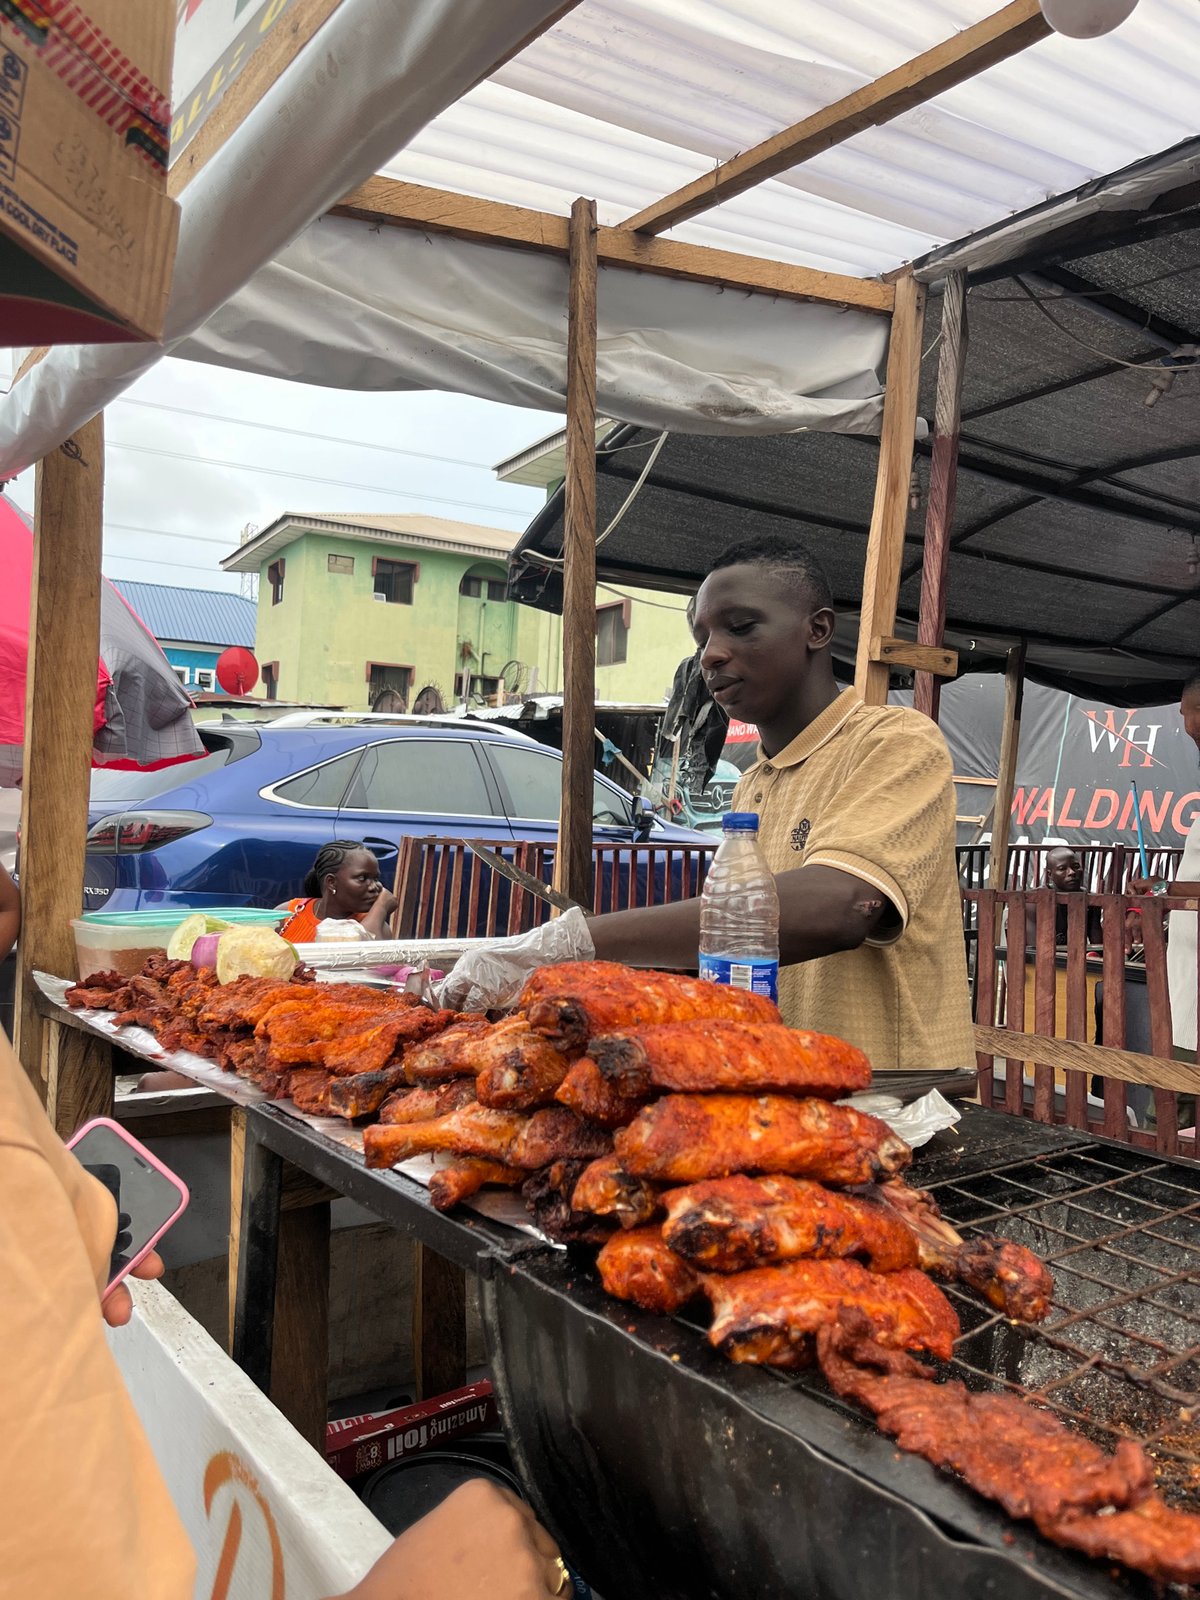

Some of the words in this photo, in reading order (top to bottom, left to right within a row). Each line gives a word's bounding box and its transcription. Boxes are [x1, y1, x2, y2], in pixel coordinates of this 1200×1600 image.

[51, 238, 78, 267] PLACE
[1011, 787, 1200, 836] WALDING
[84, 886, 109, 896] RX350
[430, 1402, 488, 1441] Amazing
[387, 1424, 428, 1461] foil
